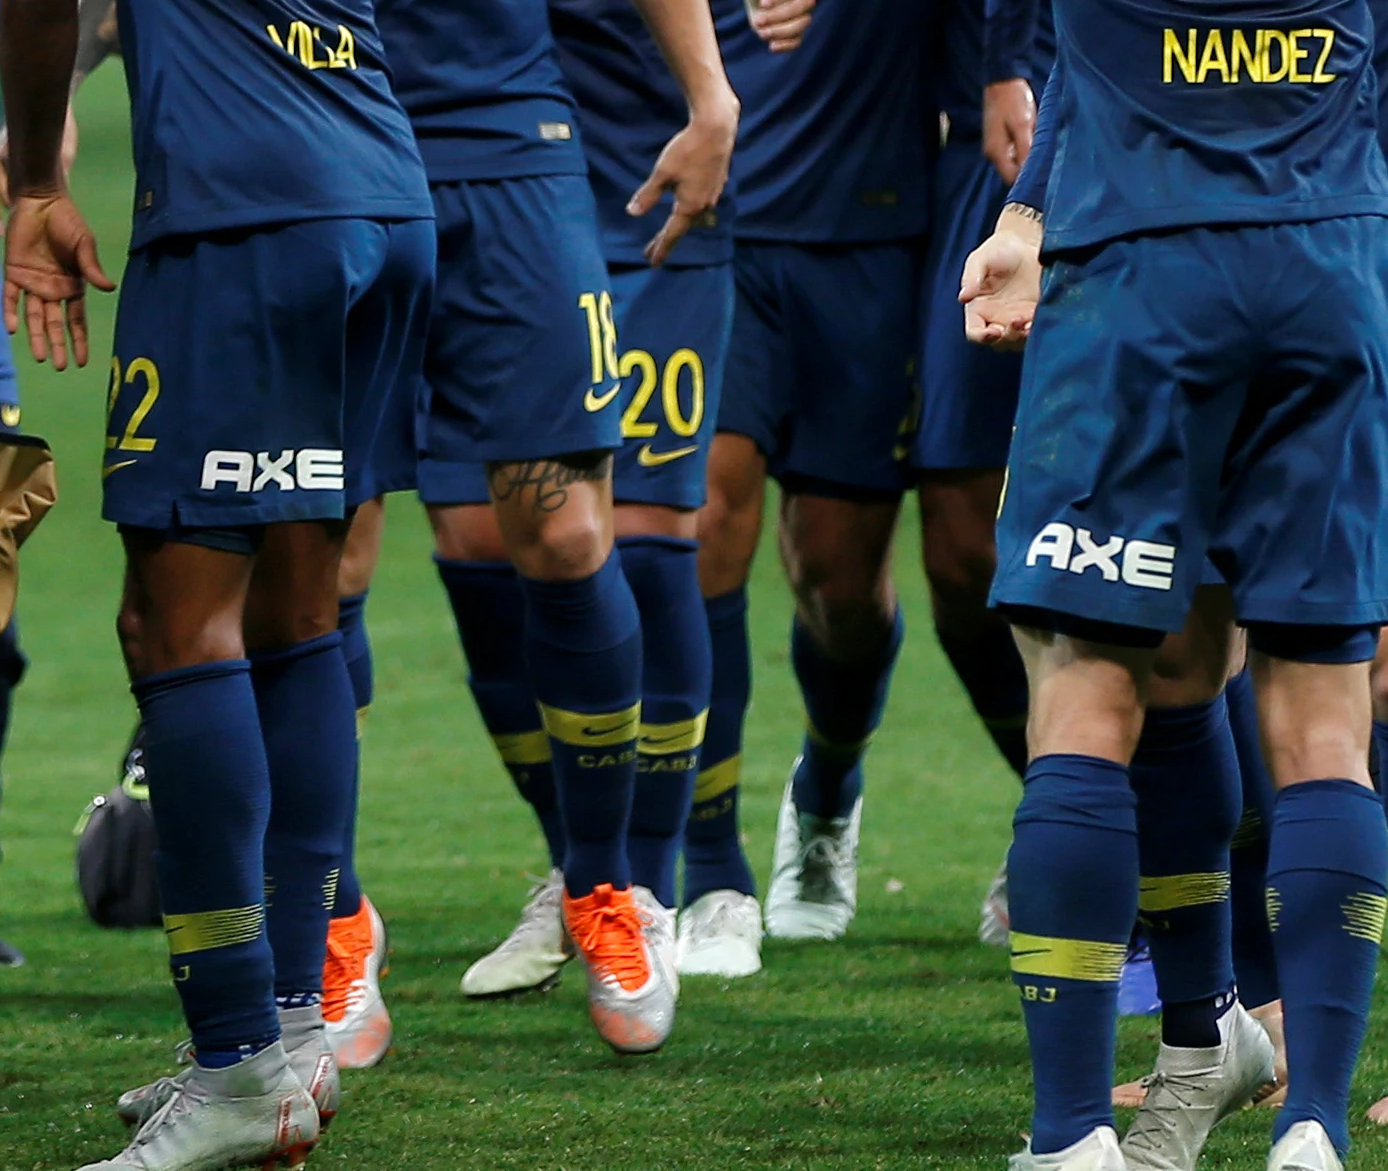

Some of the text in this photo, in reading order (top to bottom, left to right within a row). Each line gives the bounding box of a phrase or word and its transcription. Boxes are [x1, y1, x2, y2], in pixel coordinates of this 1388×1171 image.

[1162, 27, 1337, 84] NANDEZ
[618, 347, 705, 438] 20
[200, 447, 345, 493] AXE
[1025, 521, 1177, 591] AXE
